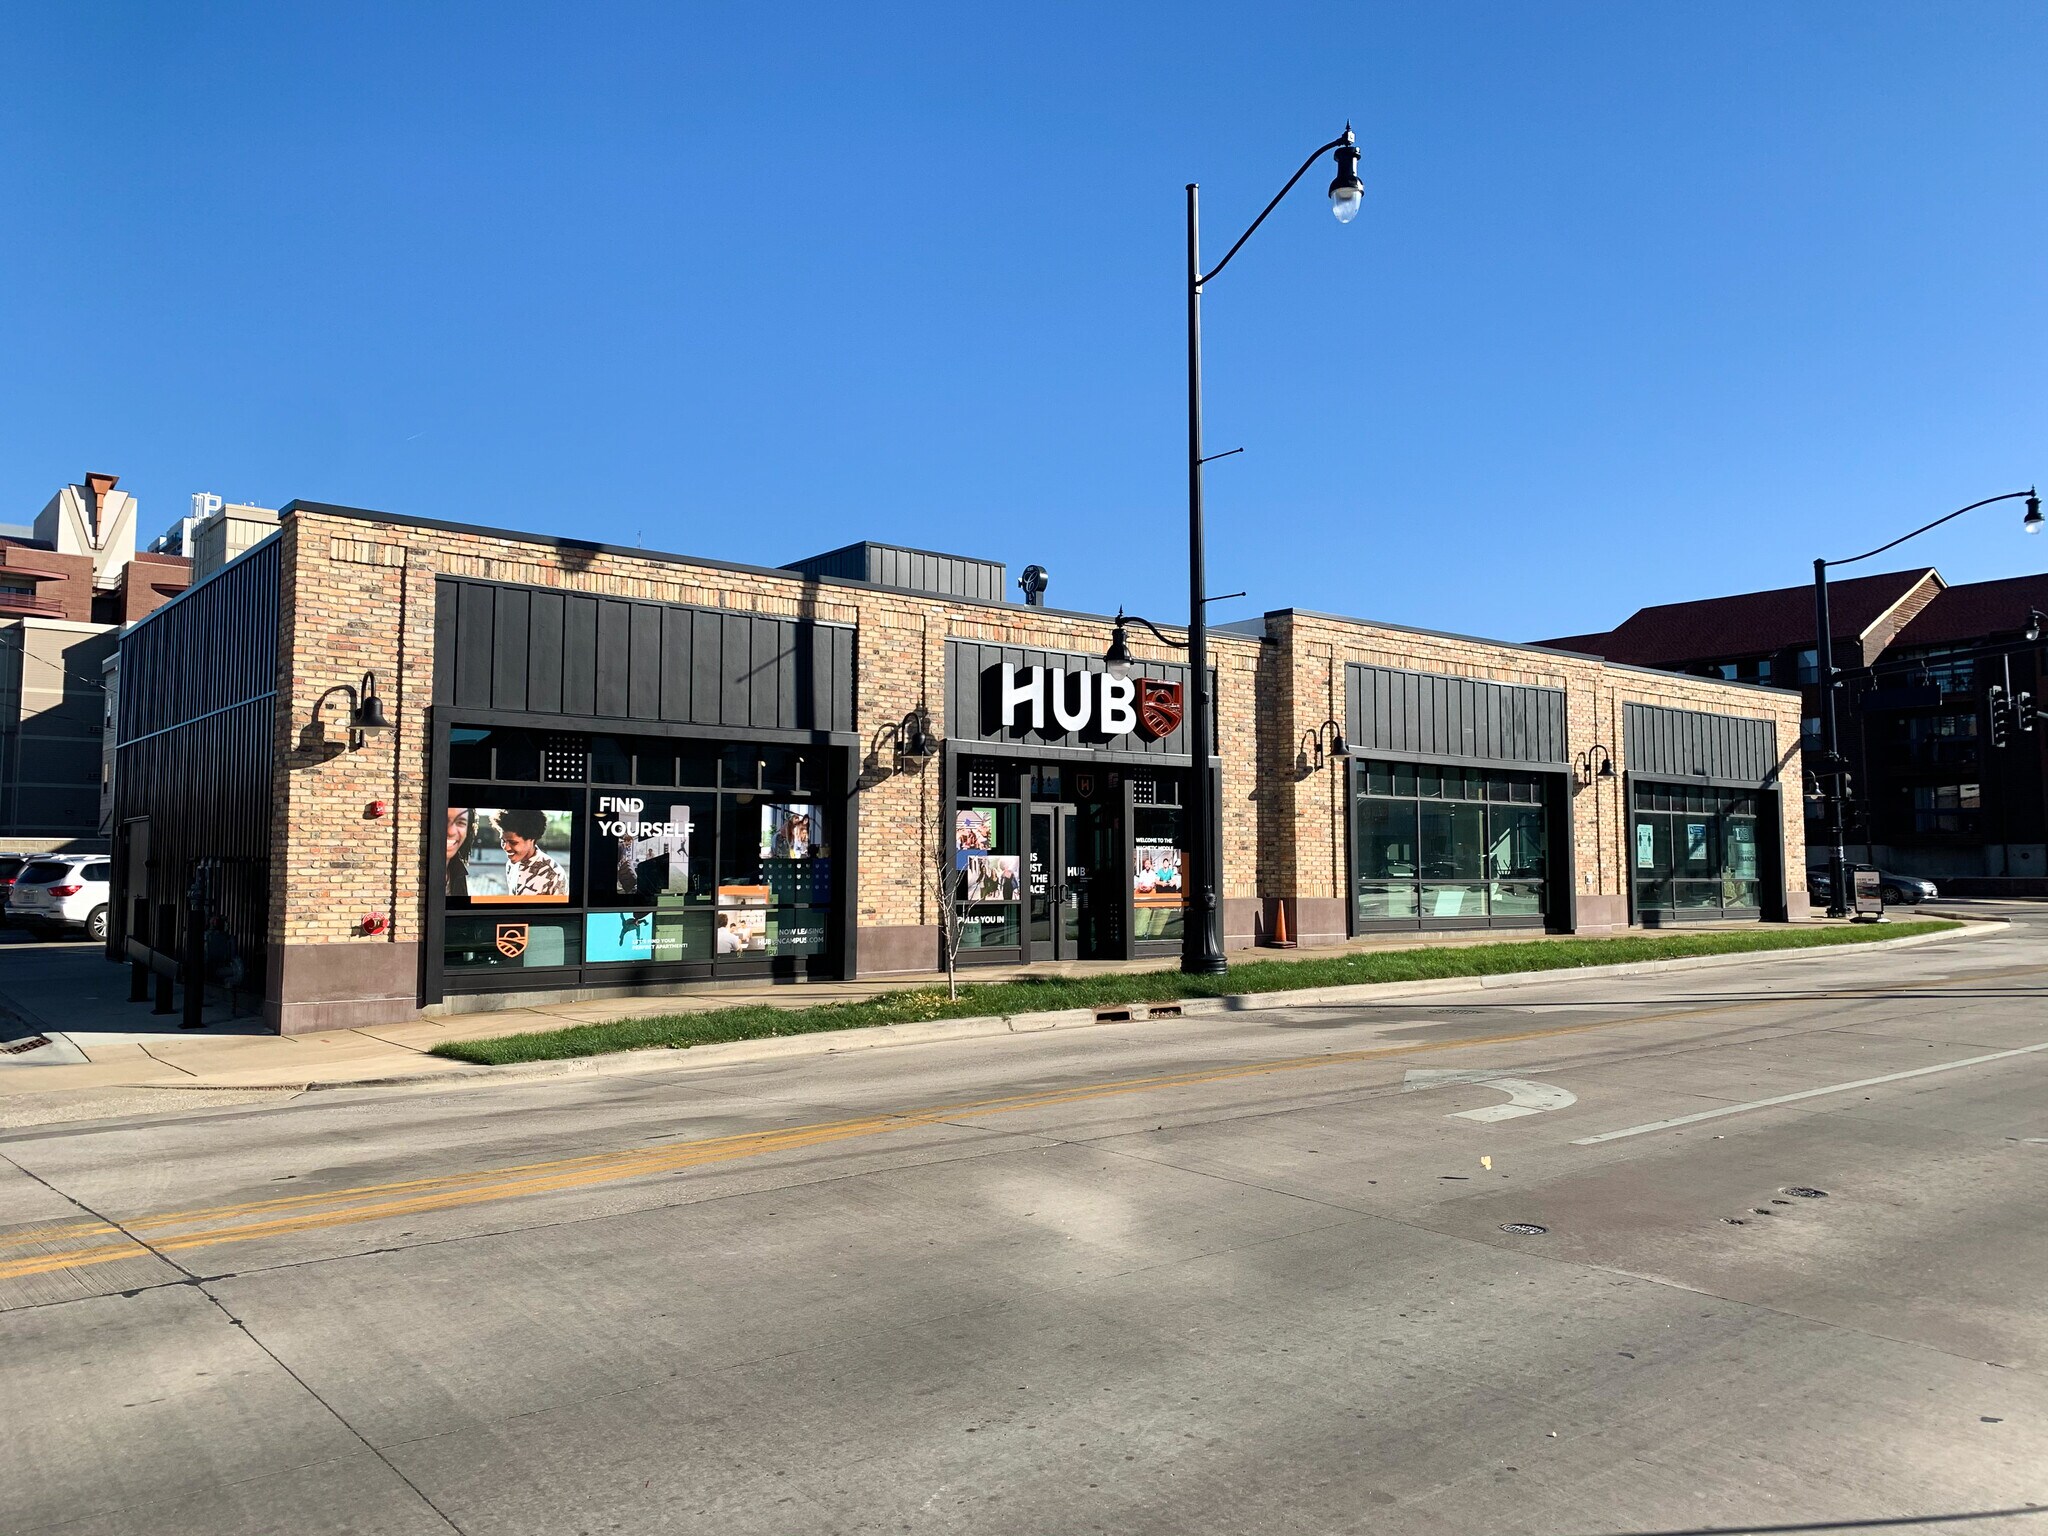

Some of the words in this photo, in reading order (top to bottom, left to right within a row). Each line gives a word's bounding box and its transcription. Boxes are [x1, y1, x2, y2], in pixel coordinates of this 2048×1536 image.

[1002, 662, 1137, 735] HUB
[599, 796, 645, 813] FIND
[598, 821, 695, 838] YOURSELF
[1067, 866, 1086, 877] HUB
[1031, 874, 1048, 883] THE
[980, 916, 996, 924] YOU
[779, 928, 797, 936] NOW
[797, 927, 824, 935] LEASING
